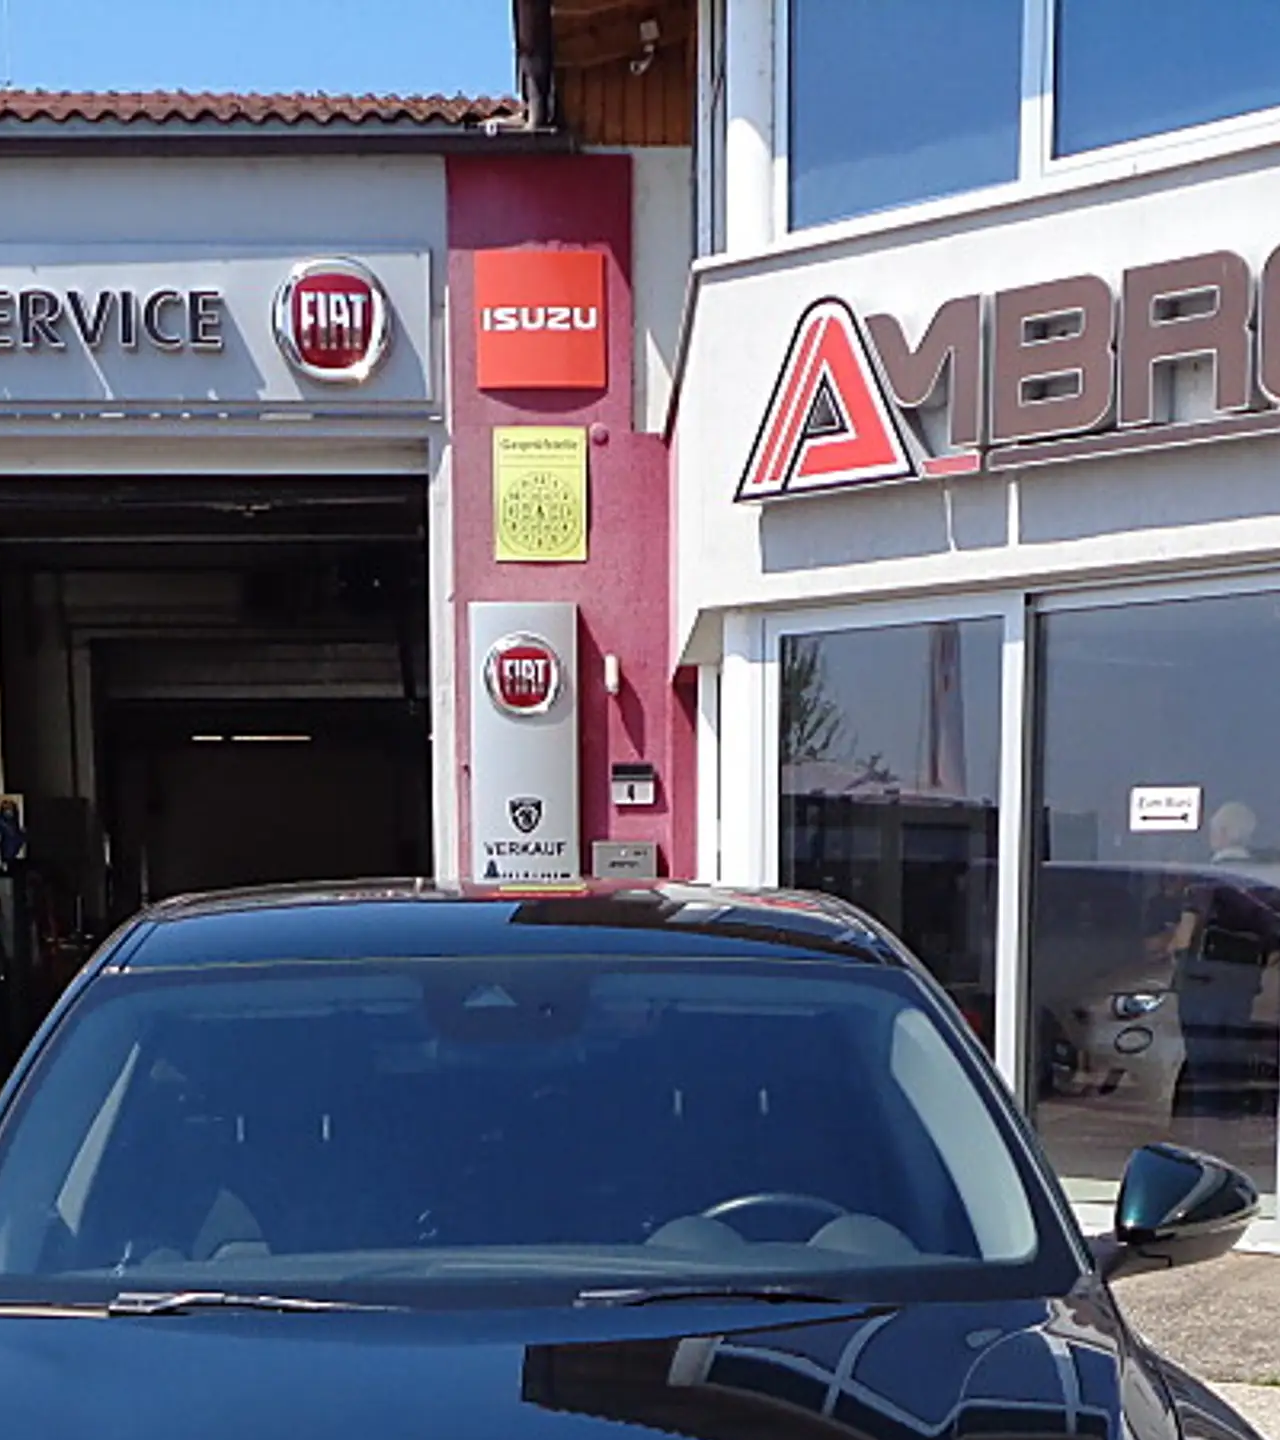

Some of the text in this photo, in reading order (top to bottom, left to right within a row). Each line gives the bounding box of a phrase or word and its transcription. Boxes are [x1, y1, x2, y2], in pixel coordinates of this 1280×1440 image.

[300, 290, 368, 348] FIAT
[482, 307, 597, 330] ISUZU
[503, 658, 547, 695] FIAT
[484, 841, 567, 857] VERKAUF
